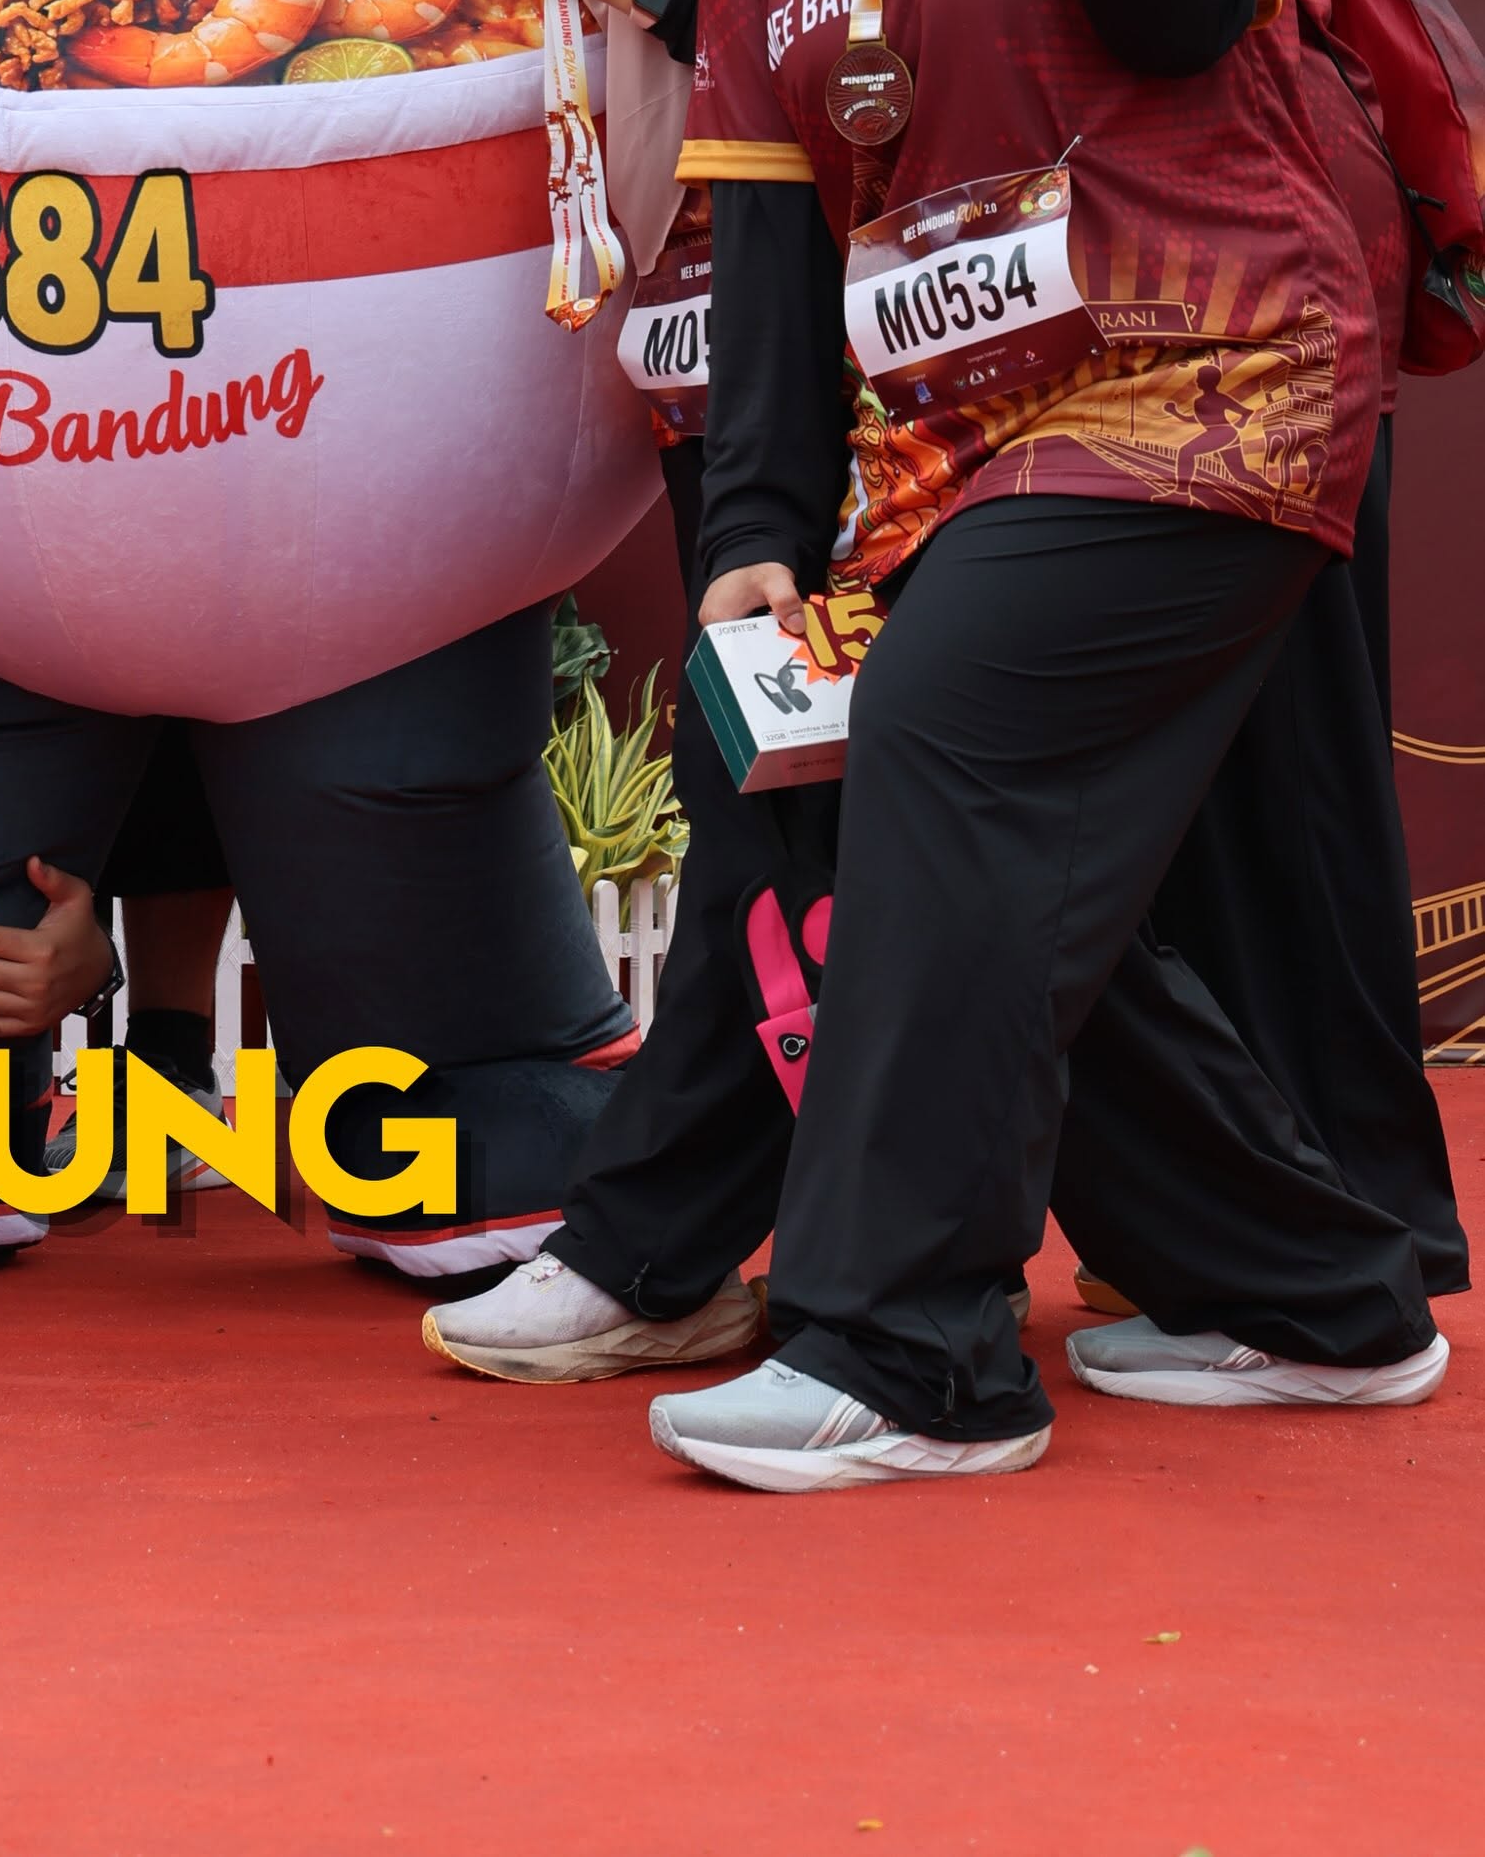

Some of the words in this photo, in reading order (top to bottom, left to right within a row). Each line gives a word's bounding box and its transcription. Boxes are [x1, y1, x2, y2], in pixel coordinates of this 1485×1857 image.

[562, 46, 578, 78] RUN
[841, 72, 895, 86] FINISHER
[902, 226, 917, 244] MEE
[916, 210, 955, 236] BANDUNG
[955, 199, 983, 225] RUN
[984, 202, 998, 215] 2.0
[680, 264, 694, 281] MEE
[875, 242, 1037, 355] M0534
[1098, 310, 1157, 329] RANI
[804, 593, 885, 668] 15
